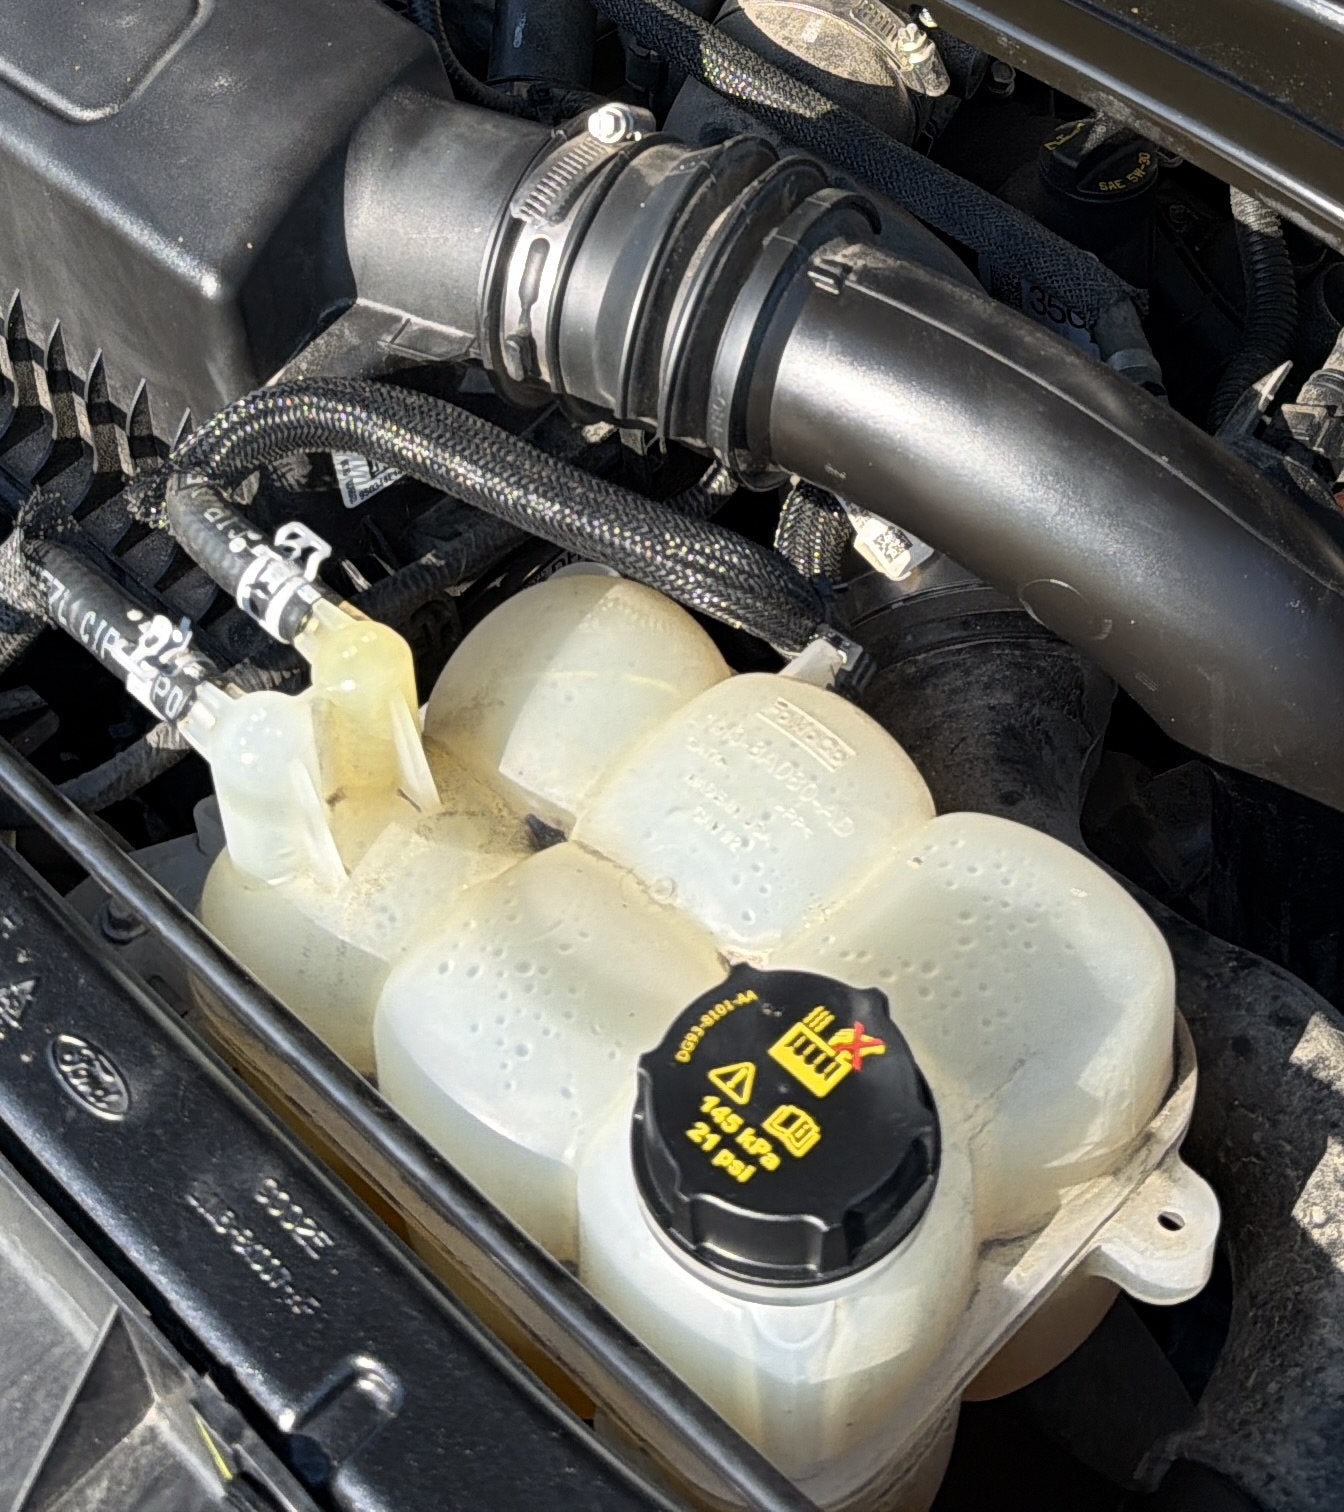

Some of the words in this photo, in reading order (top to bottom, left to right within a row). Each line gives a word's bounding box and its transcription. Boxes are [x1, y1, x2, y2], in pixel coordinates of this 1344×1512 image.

[1097, 178, 1125, 191] SAE
[56, 1040, 127, 1115] Ford
[685, 1122, 722, 1152] 21
[711, 1148, 757, 1184] psi
[700, 1095, 744, 1134] 145
[736, 1127, 782, 1172] kPa
